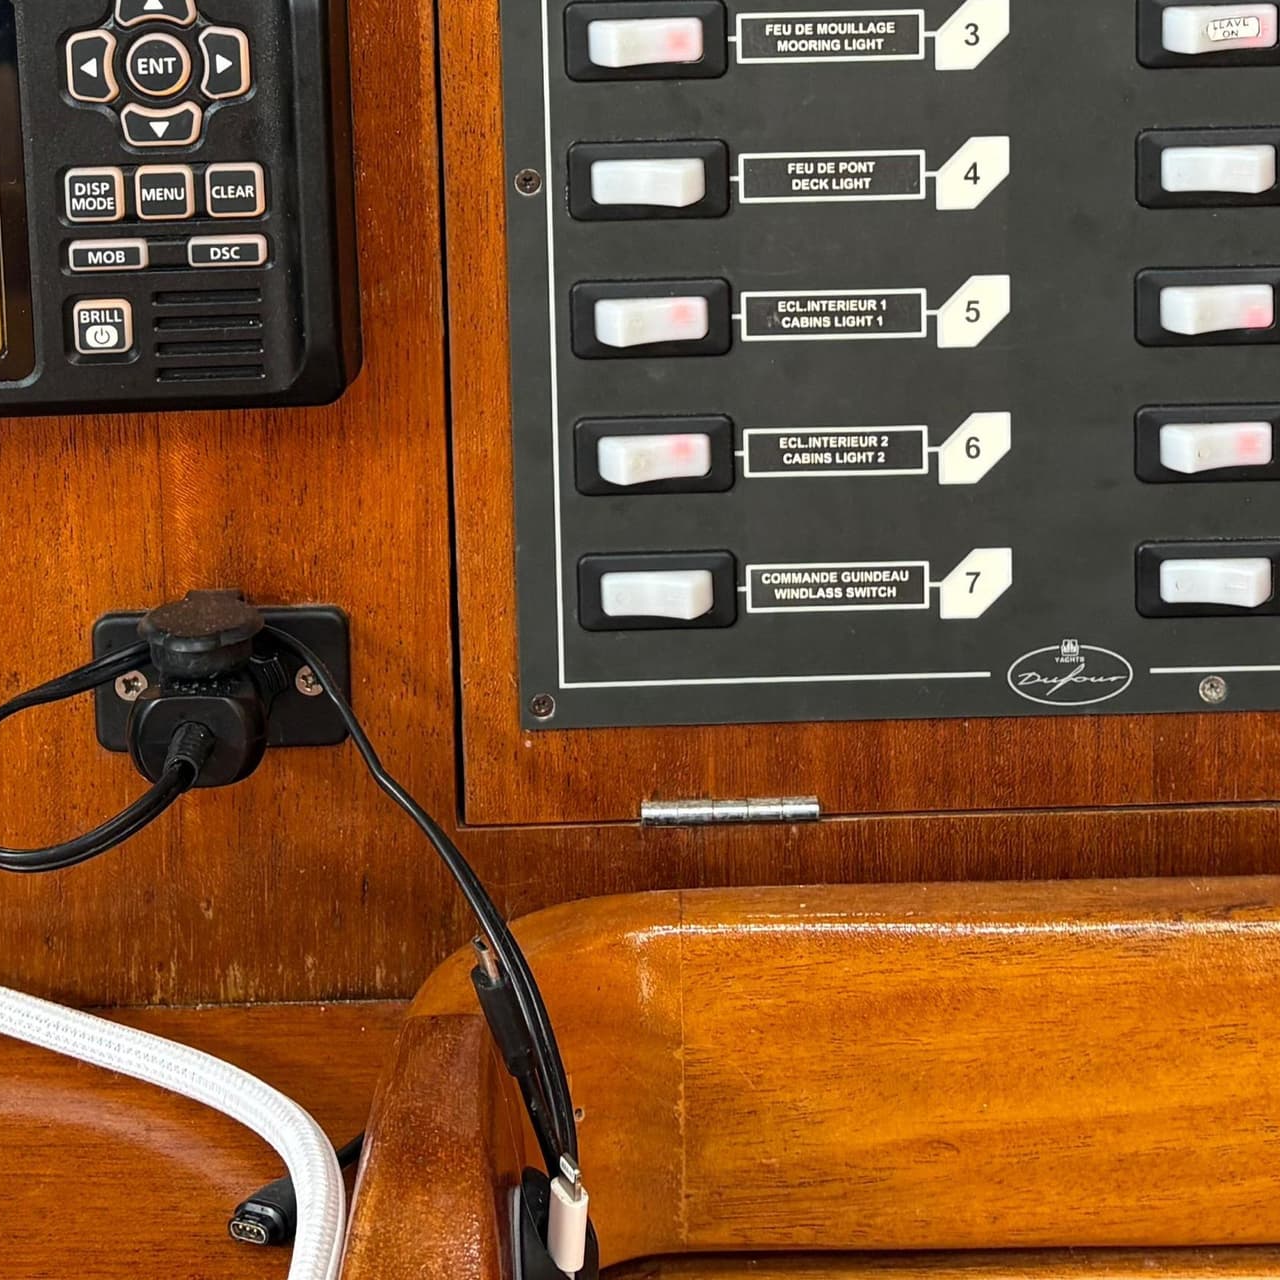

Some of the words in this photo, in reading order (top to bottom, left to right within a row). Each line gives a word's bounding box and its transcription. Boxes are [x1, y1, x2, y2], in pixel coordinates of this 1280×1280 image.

[766, 24, 792, 36] FEU
[796, 24, 813, 35] DE
[817, 22, 895, 34] MOUILLAGE
[964, 23, 980, 46] 3
[777, 40, 841, 52] MOORING
[844, 39, 884, 50] LIGHT
[138, 58, 175, 74] ENT
[964, 162, 980, 184] 4
[75, 182, 110, 196] DISP
[792, 178, 828, 190] DECK
[832, 178, 871, 190] LIGHT
[142, 187, 184, 201] MENU
[212, 185, 254, 199] CLEAR
[72, 197, 114, 211] MODE
[88, 251, 125, 264] MOB
[210, 247, 239, 260] DSC
[80, 310, 121, 323] BRILL
[965, 300, 980, 322] 5
[782, 316, 830, 328] CABINS
[834, 316, 873, 327] LIGHT
[877, 316, 883, 326] 1
[965, 436, 980, 458] 6
[762, 572, 838, 584] COMMANDE
[842, 571, 909, 583] GUINDEAU
[965, 572, 981, 593] 7
[774, 587, 843, 599] WINDLASS
[846, 586, 896, 598] SWITCH
[1018, 663, 1128, 696] Dufour
